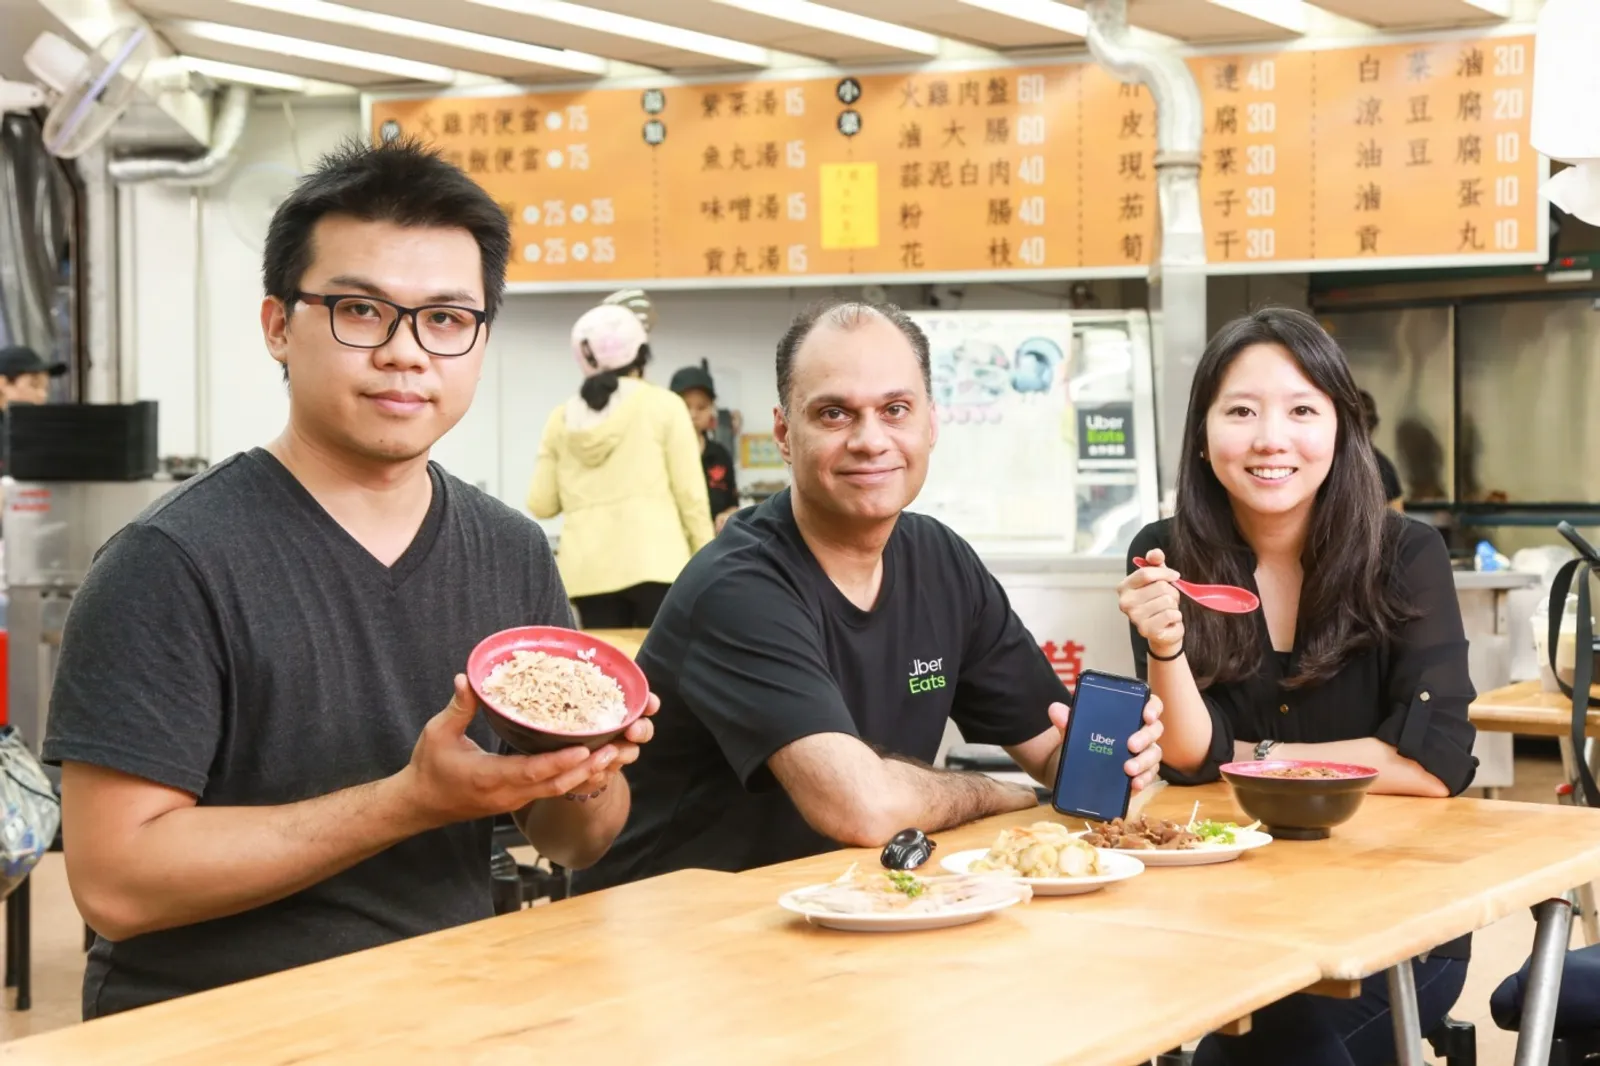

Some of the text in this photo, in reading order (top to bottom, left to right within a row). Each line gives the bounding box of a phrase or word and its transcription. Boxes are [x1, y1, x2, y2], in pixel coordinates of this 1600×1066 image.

[1493, 44, 1524, 76] 30
[1017, 74, 1045, 104] 60
[1246, 60, 1275, 91] 40
[1247, 101, 1276, 133] 30
[1493, 89, 1523, 120] 20
[1017, 115, 1045, 145] 60
[701, 141, 779, 171] 魚丸湯
[1246, 145, 1275, 176] 30
[1355, 132, 1519, 170] 油豆腐 10
[1018, 155, 1045, 184] 40
[1247, 186, 1276, 217] 30
[1495, 176, 1519, 207] 10
[1018, 196, 1045, 225] 40
[1246, 228, 1275, 259] 30
[1495, 219, 1518, 249] 10
[1018, 235, 1045, 265] 40
[1085, 414, 1124, 430] Uber
[909, 675, 946, 694] Eats
[1088, 742, 1113, 755] Eats
[1090, 732, 1116, 746] Uber
